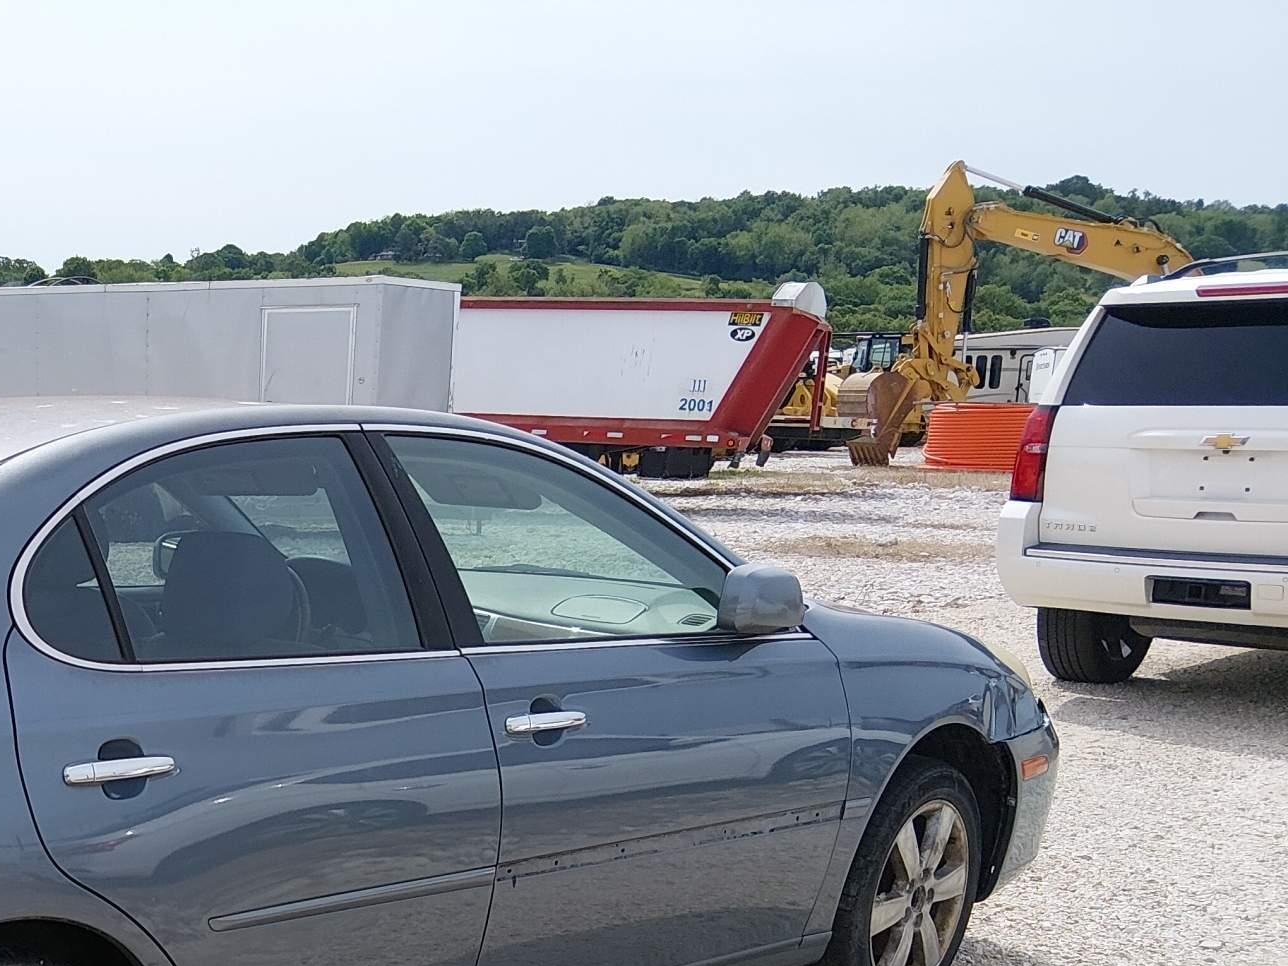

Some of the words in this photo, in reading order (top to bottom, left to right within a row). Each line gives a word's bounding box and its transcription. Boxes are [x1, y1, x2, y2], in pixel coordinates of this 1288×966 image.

[1054, 227, 1083, 249] CAT
[734, 328, 753, 340] XP
[678, 397, 714, 412] 2001
